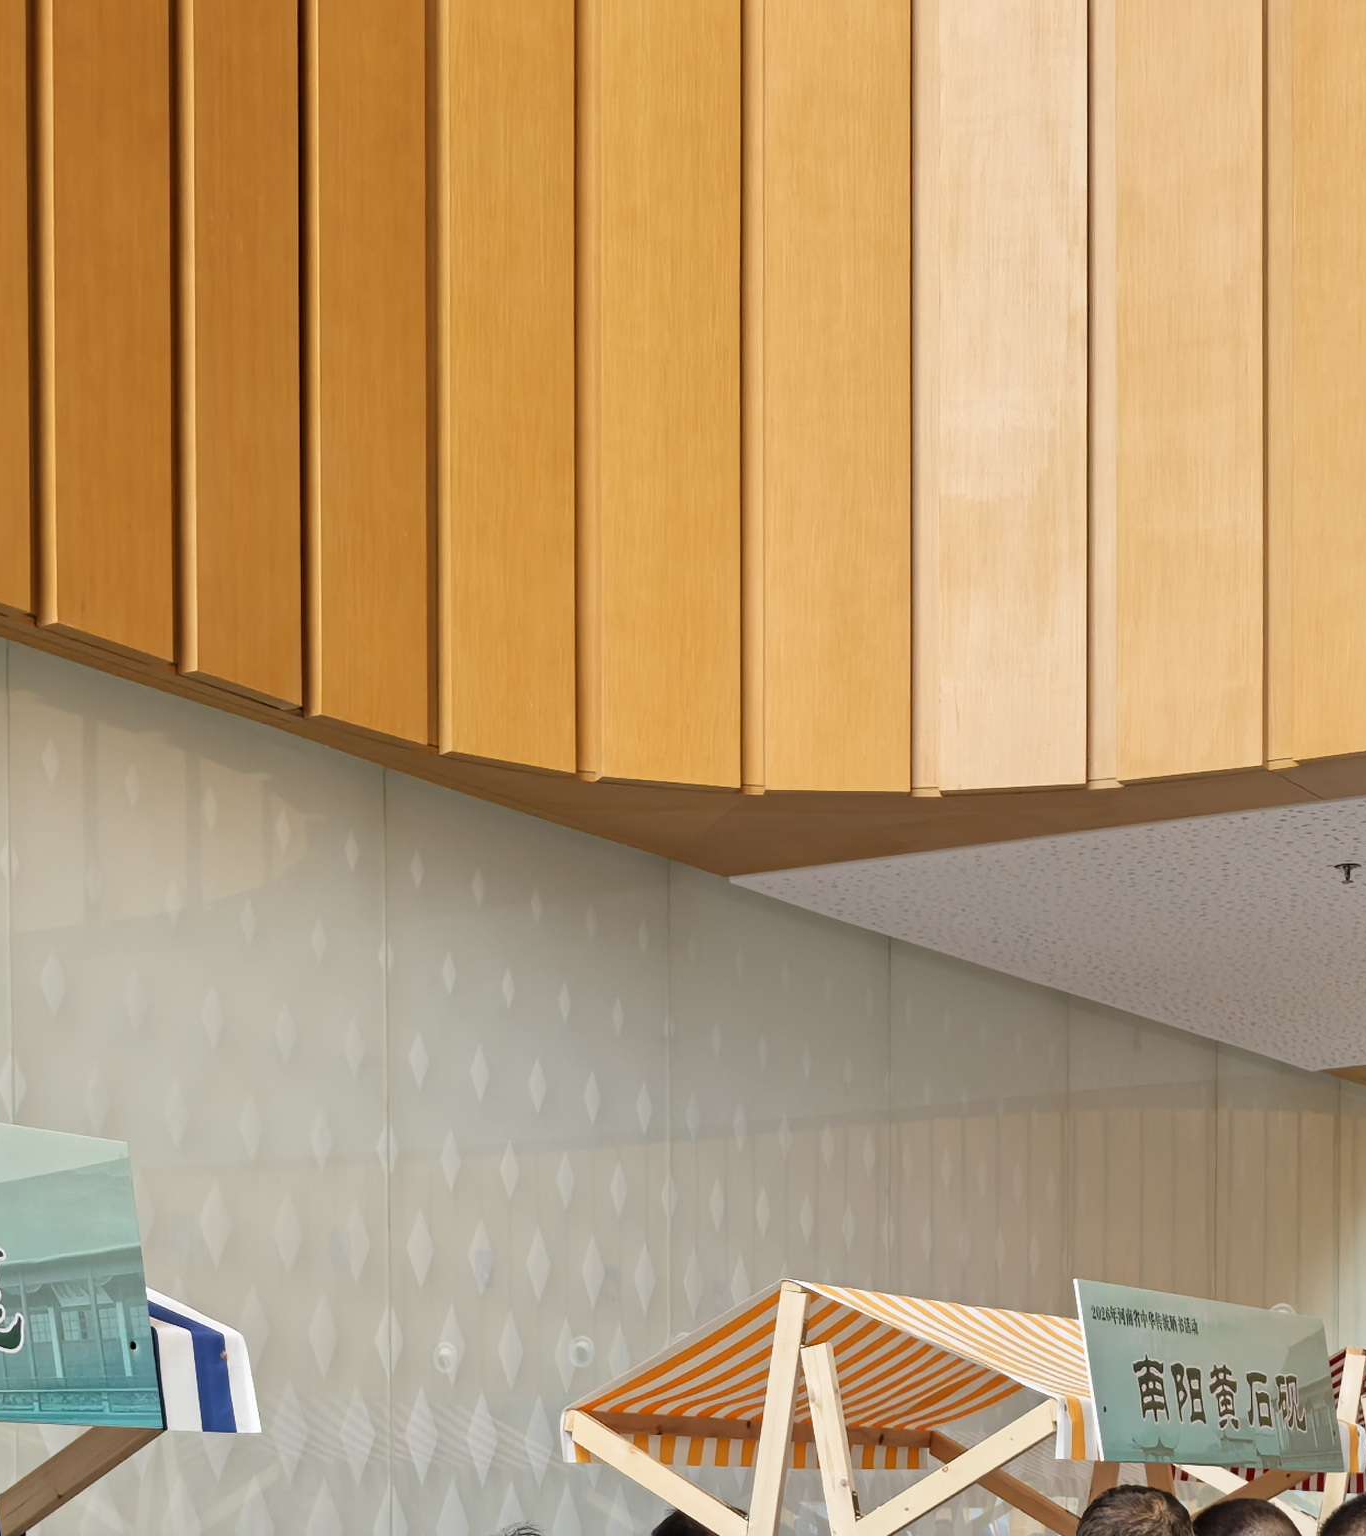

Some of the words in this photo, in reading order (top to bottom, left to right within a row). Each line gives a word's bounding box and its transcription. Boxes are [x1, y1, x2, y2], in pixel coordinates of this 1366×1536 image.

[1132, 1354, 1308, 1433] 南阳黄石砚
